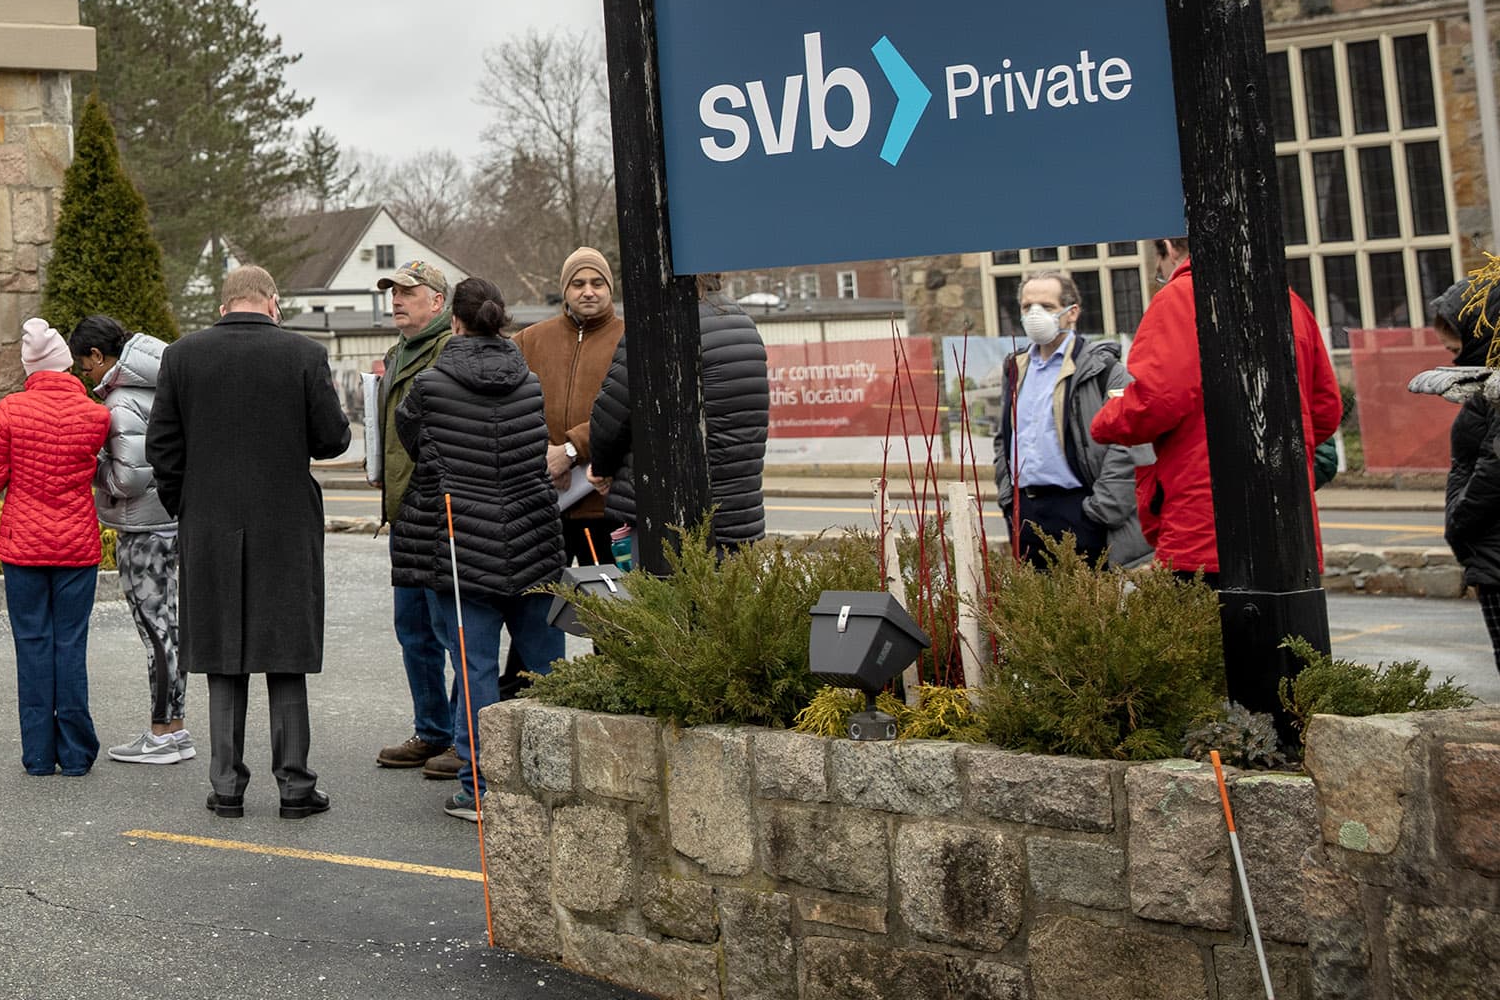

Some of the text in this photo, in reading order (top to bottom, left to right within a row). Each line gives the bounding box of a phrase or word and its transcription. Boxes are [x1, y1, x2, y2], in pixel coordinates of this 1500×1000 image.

[699, 32, 1133, 163] svb Private
[770, 385, 865, 406] this location
